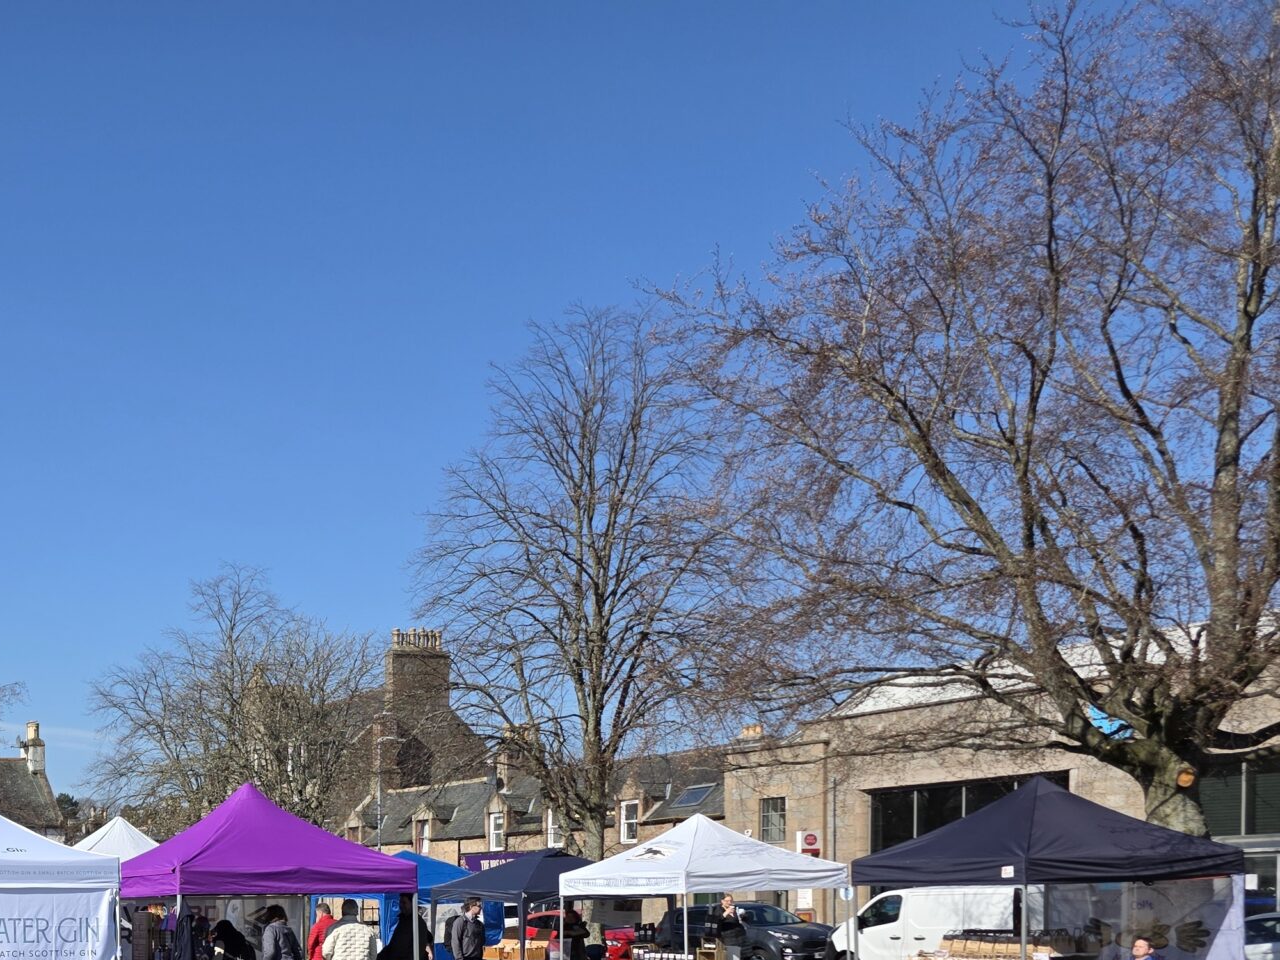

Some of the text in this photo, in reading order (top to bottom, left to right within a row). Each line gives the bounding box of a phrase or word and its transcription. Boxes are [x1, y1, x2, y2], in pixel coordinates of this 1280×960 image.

[57, 917, 100, 943] GIN
[28, 949, 75, 958] SCOTTISH
[80, 949, 97, 957] GIN
